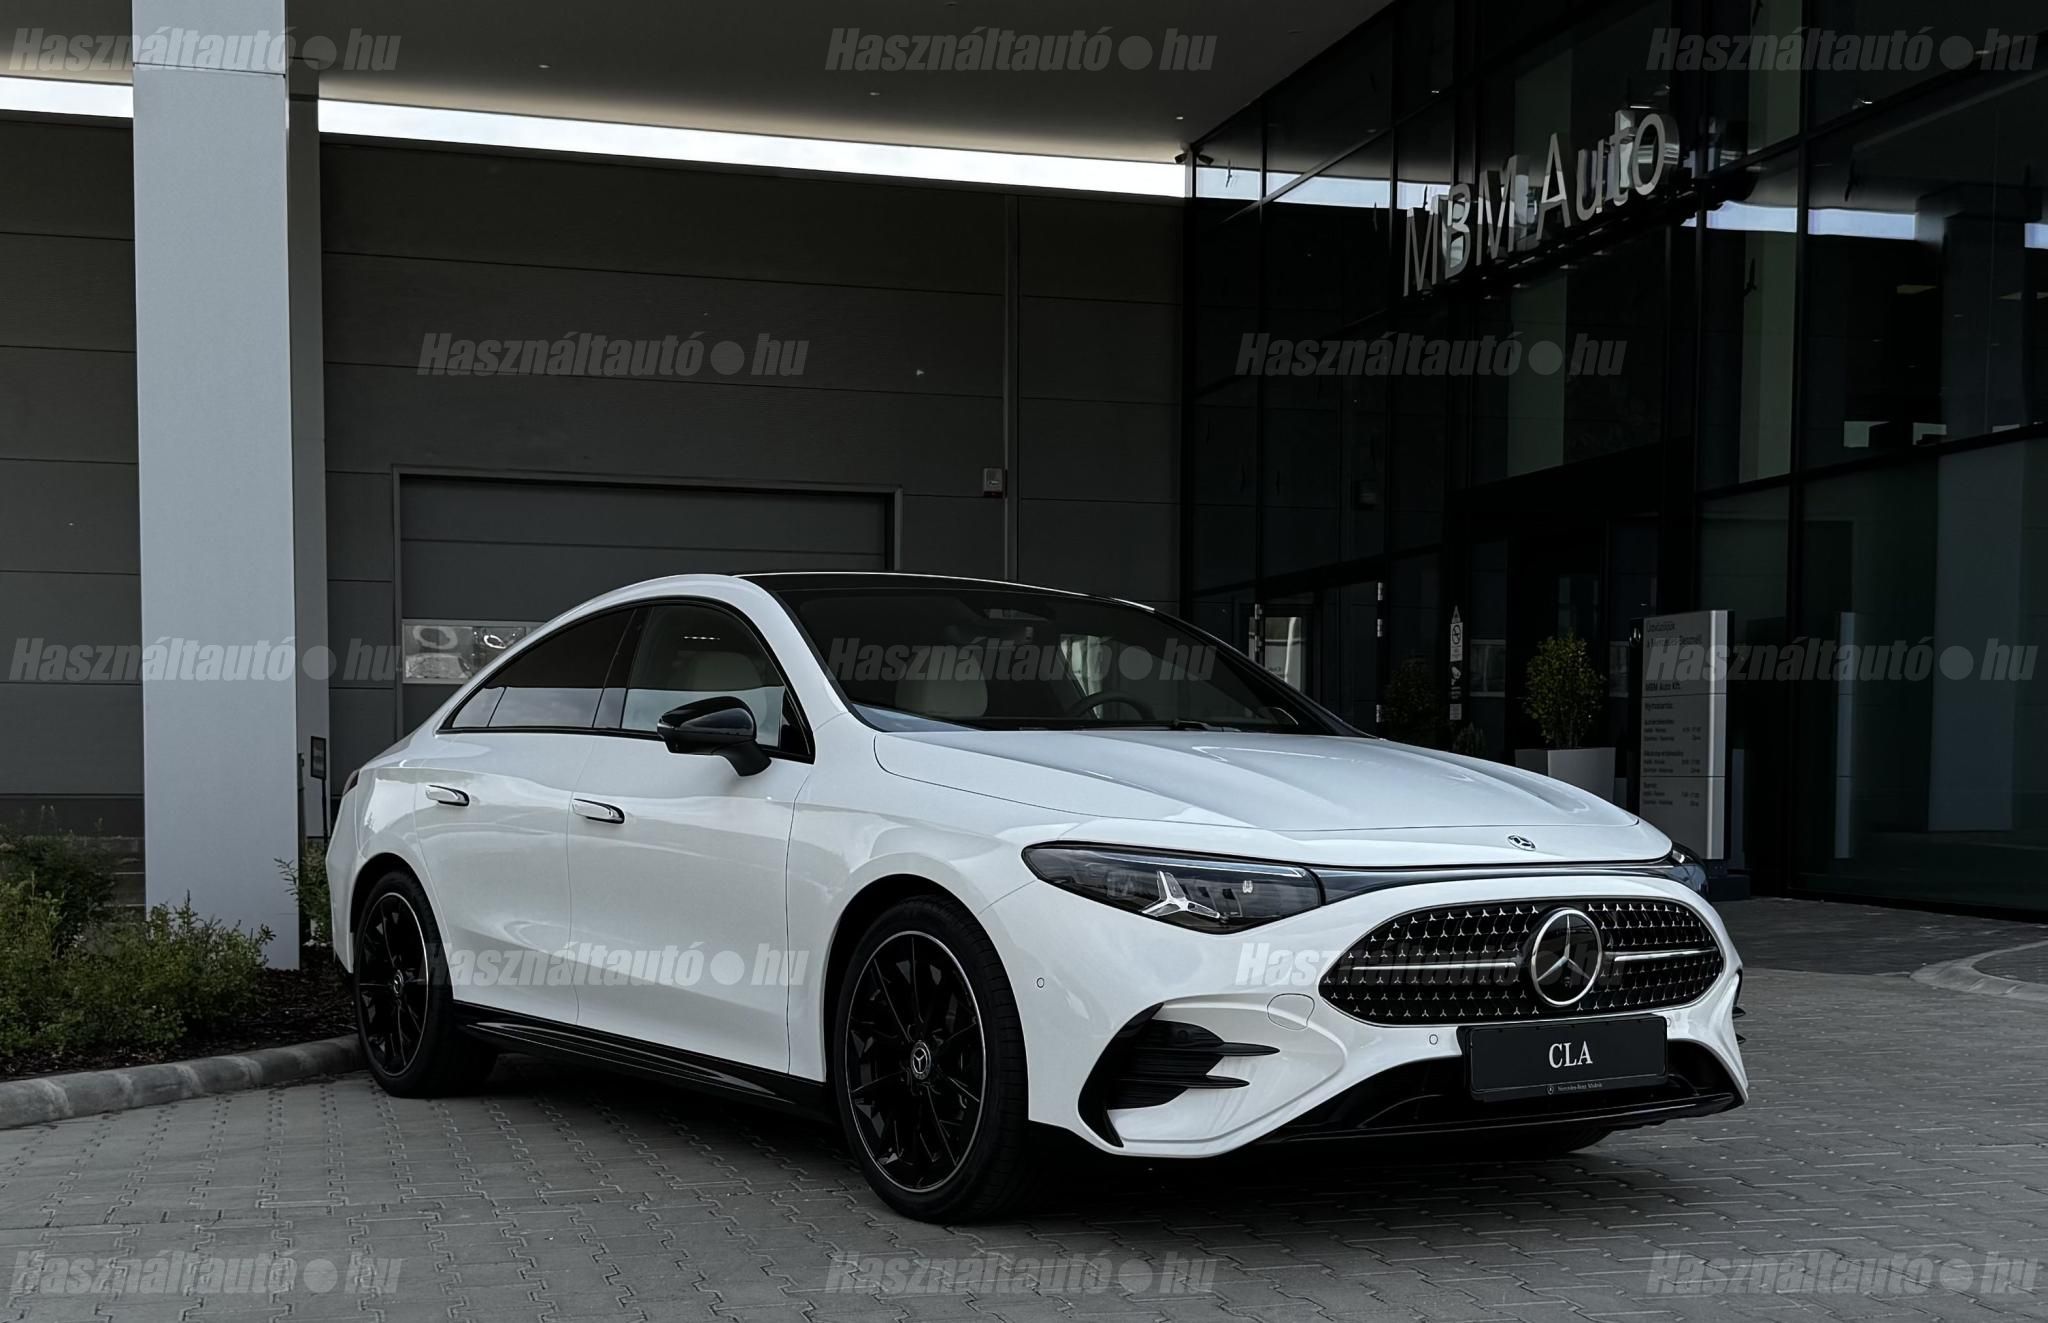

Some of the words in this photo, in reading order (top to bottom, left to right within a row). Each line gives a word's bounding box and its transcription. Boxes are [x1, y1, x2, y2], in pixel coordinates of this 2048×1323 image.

[1403, 154, 1519, 297] MBM
[1535, 109, 1672, 241] Auto
[1549, 1040, 1593, 1069] CLA
